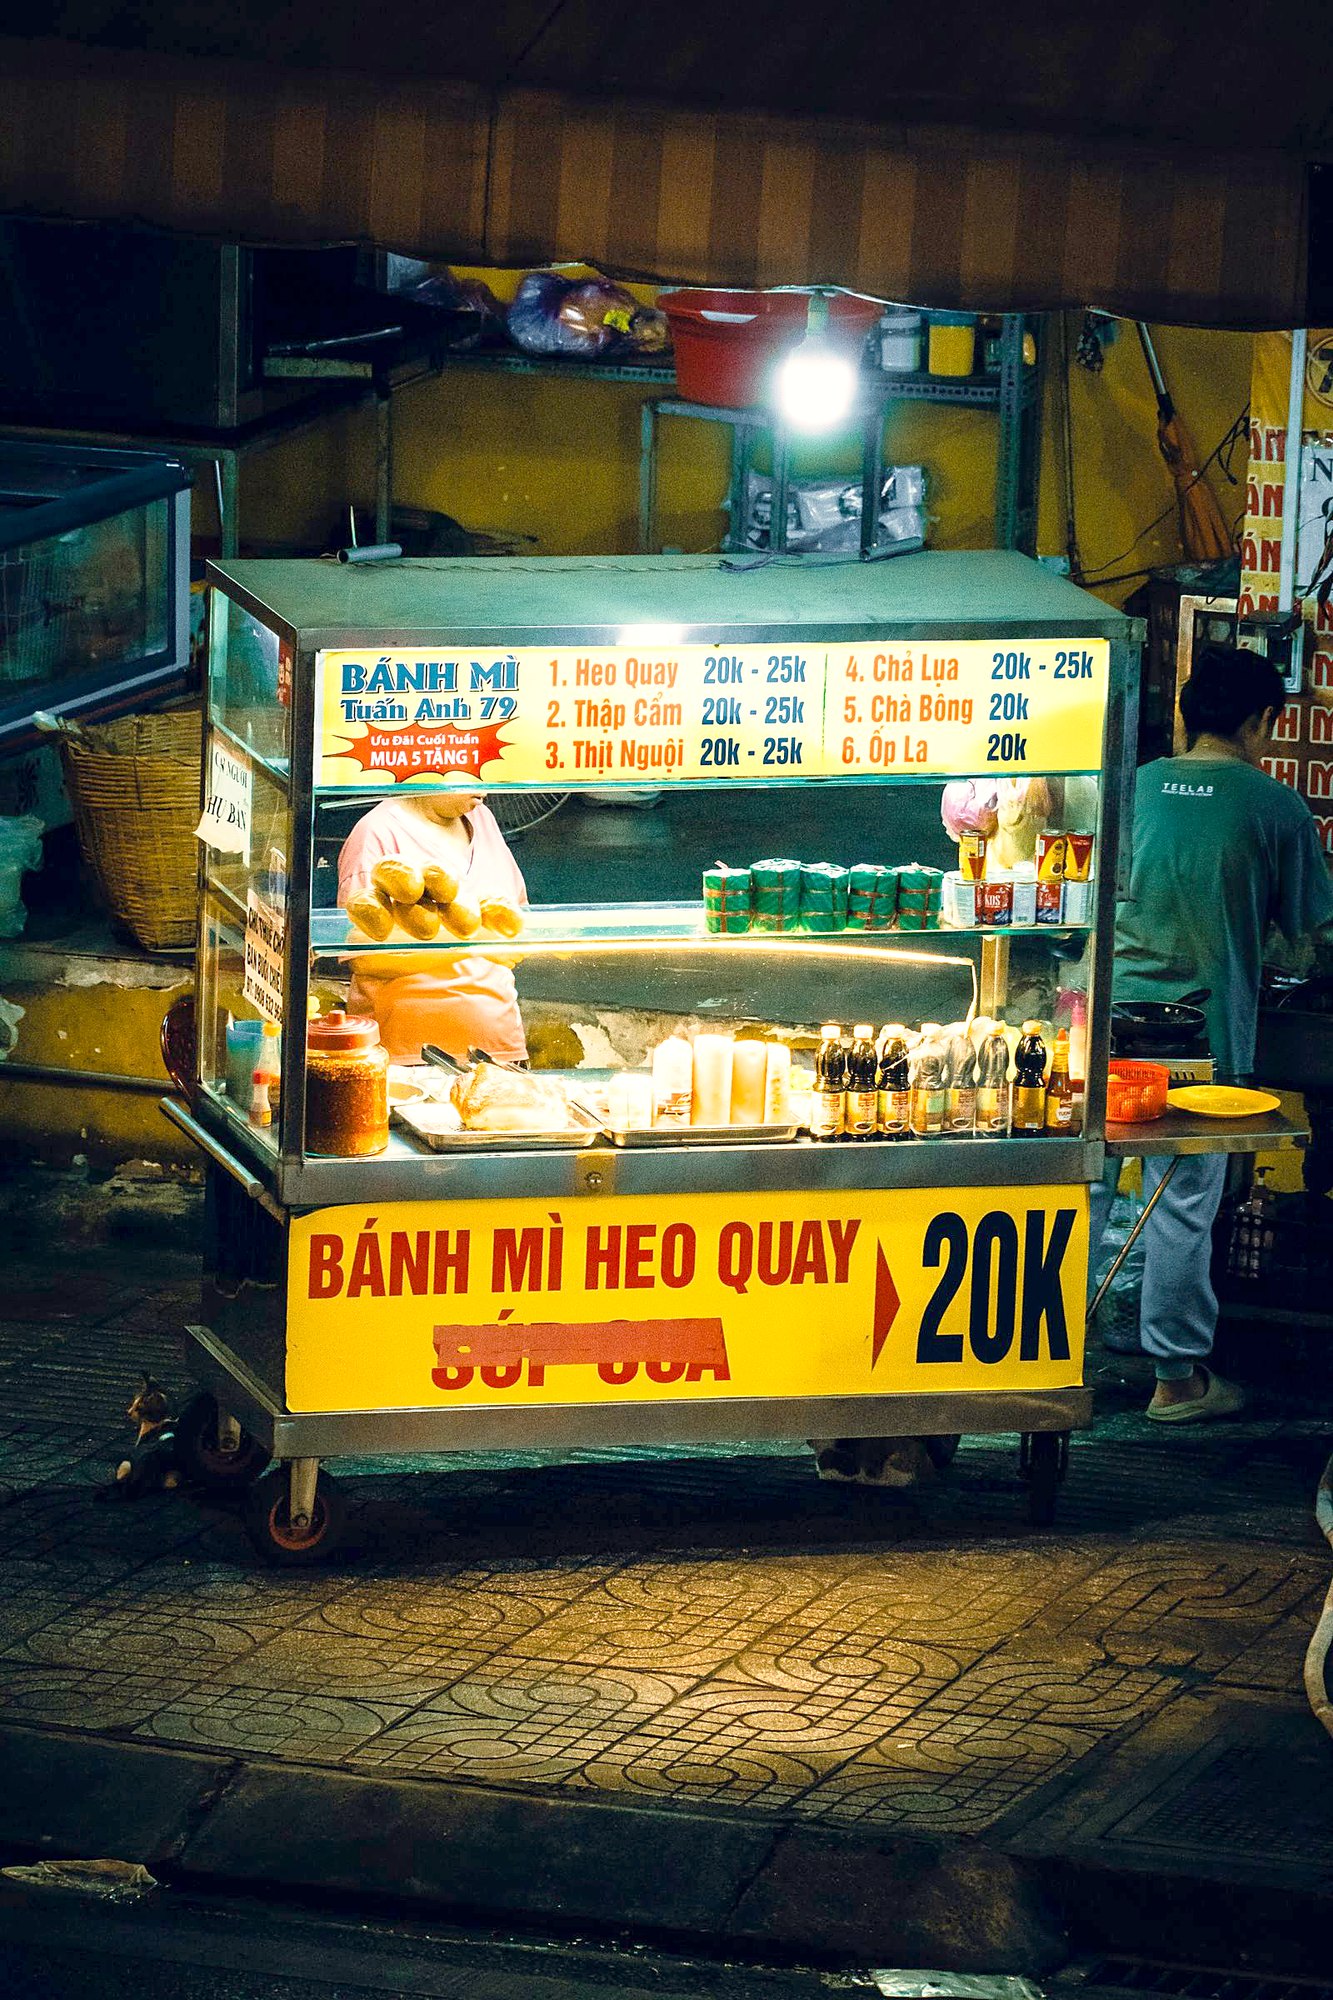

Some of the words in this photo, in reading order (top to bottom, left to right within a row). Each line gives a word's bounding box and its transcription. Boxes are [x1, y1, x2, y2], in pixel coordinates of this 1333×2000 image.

[341, 657, 458, 694] BÁNH
[469, 655, 520, 692] MÌ
[549, 659, 567, 686] 1.
[575, 658, 616, 687] Heo
[625, 660, 679, 690] Quay
[703, 656, 743, 684] 20k
[766, 655, 806, 683] 25k
[845, 656, 864, 682] 4.
[873, 649, 914, 682] Chả
[922, 658, 959, 687] Lụa
[991, 652, 1031, 680] 20k
[1053, 651, 1093, 679] 25k
[341, 698, 407, 722] Tuấn
[414, 697, 471, 721] Anh
[480, 697, 517, 720] 79
[547, 701, 566, 728] 2.
[574, 699, 626, 730] Thập
[634, 692, 683, 727] Cẩm
[702, 697, 741, 725] 20k
[764, 697, 804, 724] 25k
[844, 696, 862, 723] 5.
[871, 694, 911, 722] Chà
[919, 693, 973, 725] Bông
[989, 693, 1028, 721] 20k
[371, 734, 389, 746] Ưu
[417, 733, 446, 745] Cuối
[546, 742, 565, 769] 3.
[573, 740, 613, 774] Thịt
[621, 739, 684, 774] Nguội
[700, 738, 740, 766] 20k
[762, 737, 802, 765] 25k
[842, 736, 860, 764] 6.
[869, 725, 896, 767] Ốp
[904, 736, 927, 763] La
[987, 733, 1026, 761] 20k
[370, 750, 408, 766] MUA
[411, 751, 421, 765] 5
[424, 747, 467, 769] TẶNG
[472, 750, 479, 764] 1
[1163, 782, 1214, 793] TEELAB
[308, 1217, 470, 1299] BÁNH
[491, 1212, 563, 1293] MÌ
[584, 1222, 696, 1290] HEO
[717, 1219, 861, 1294] QUAY
[916, 1209, 1077, 1364] 20K
